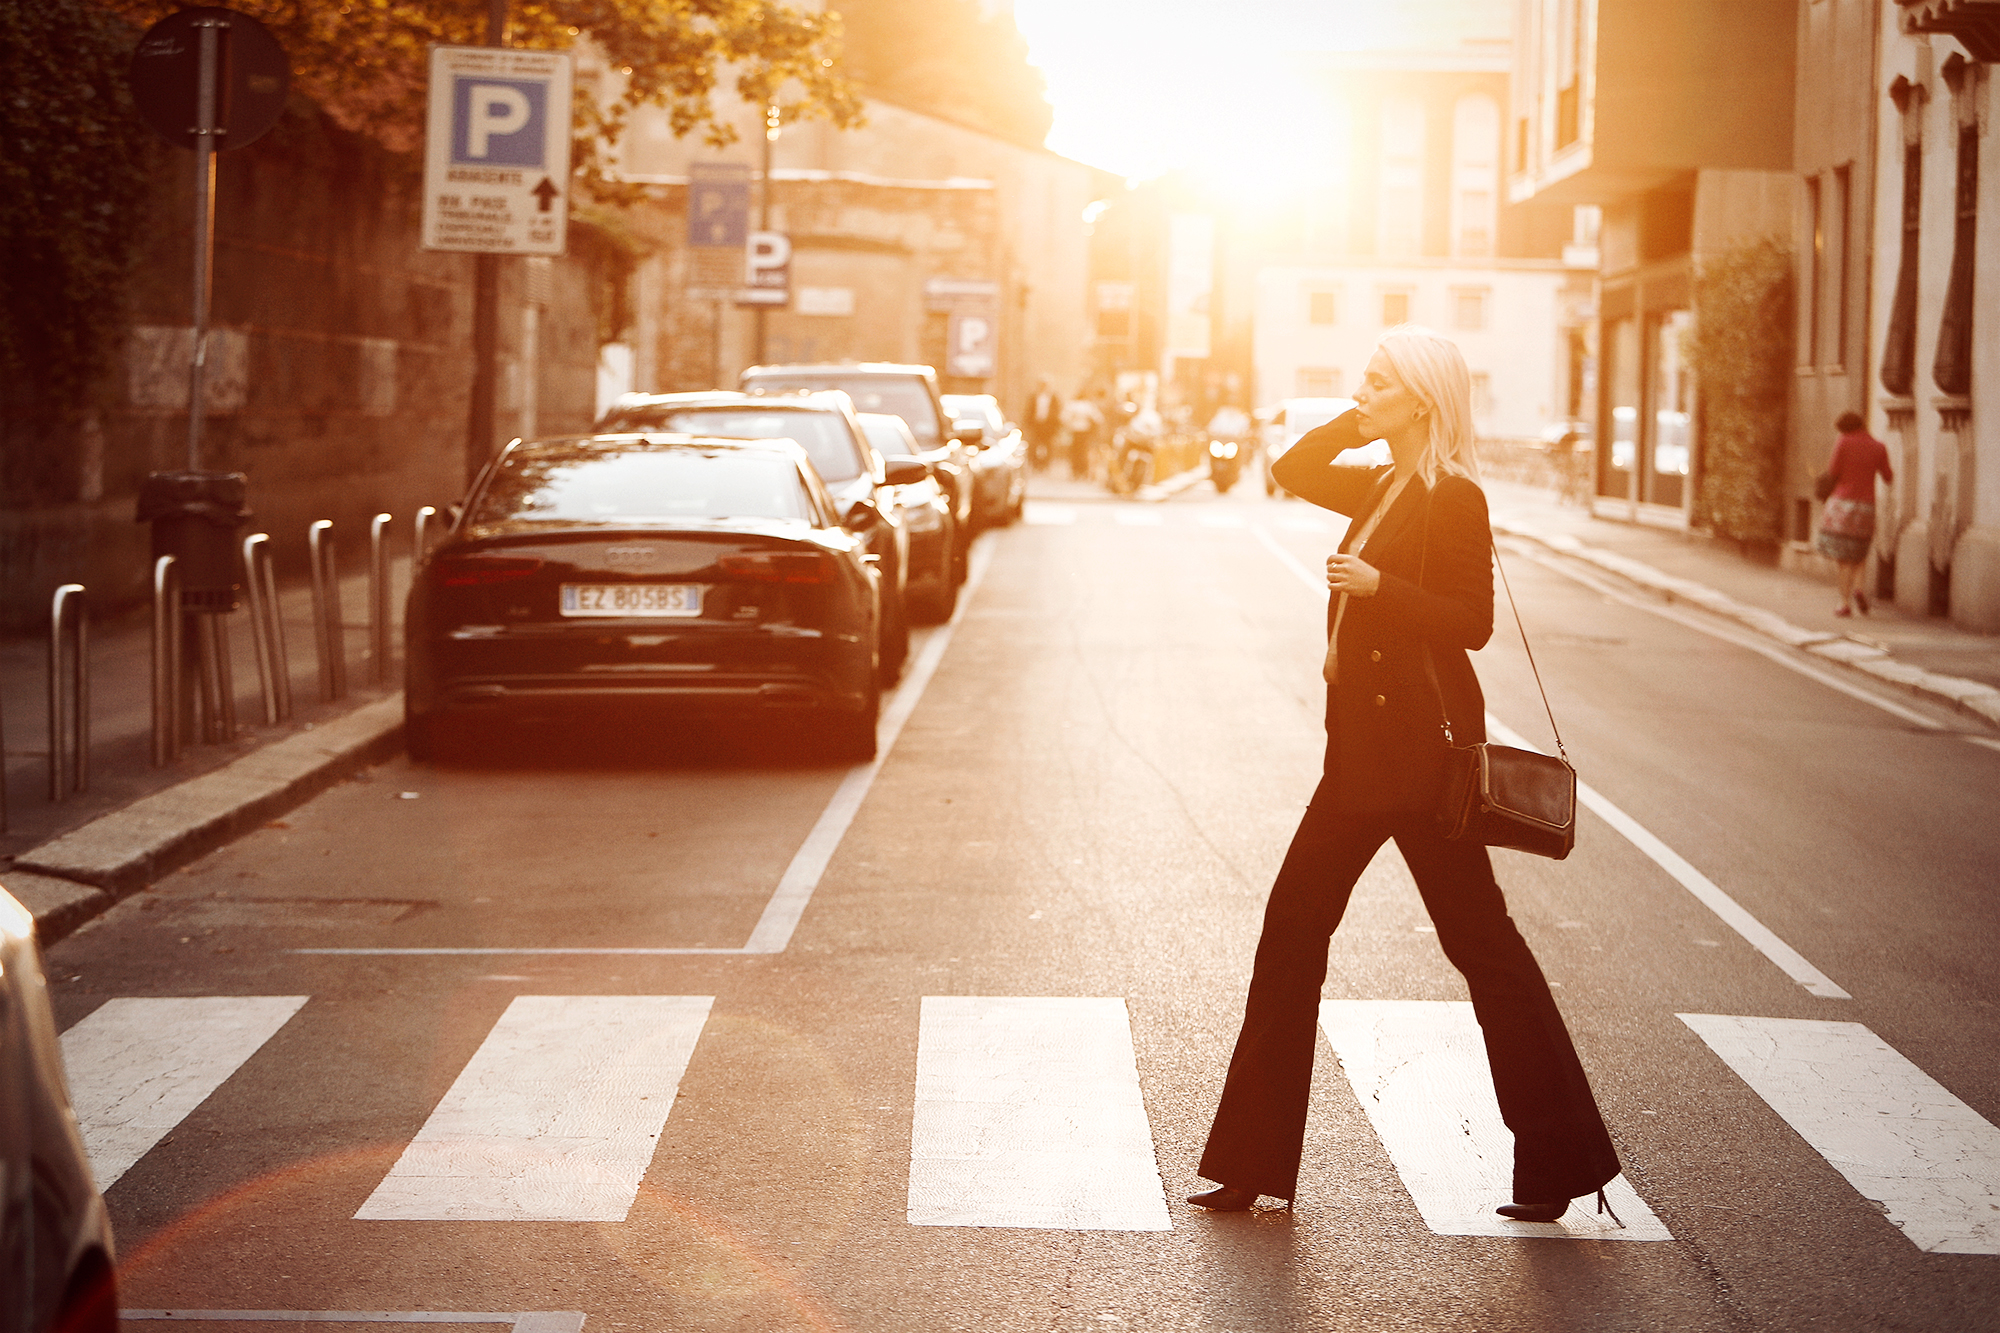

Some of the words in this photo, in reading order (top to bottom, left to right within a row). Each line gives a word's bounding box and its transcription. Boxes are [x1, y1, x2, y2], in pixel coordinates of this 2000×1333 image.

[468, 86, 531, 158] P
[747, 232, 791, 284] P
[960, 318, 987, 352] P
[580, 587, 605, 609] EZ
